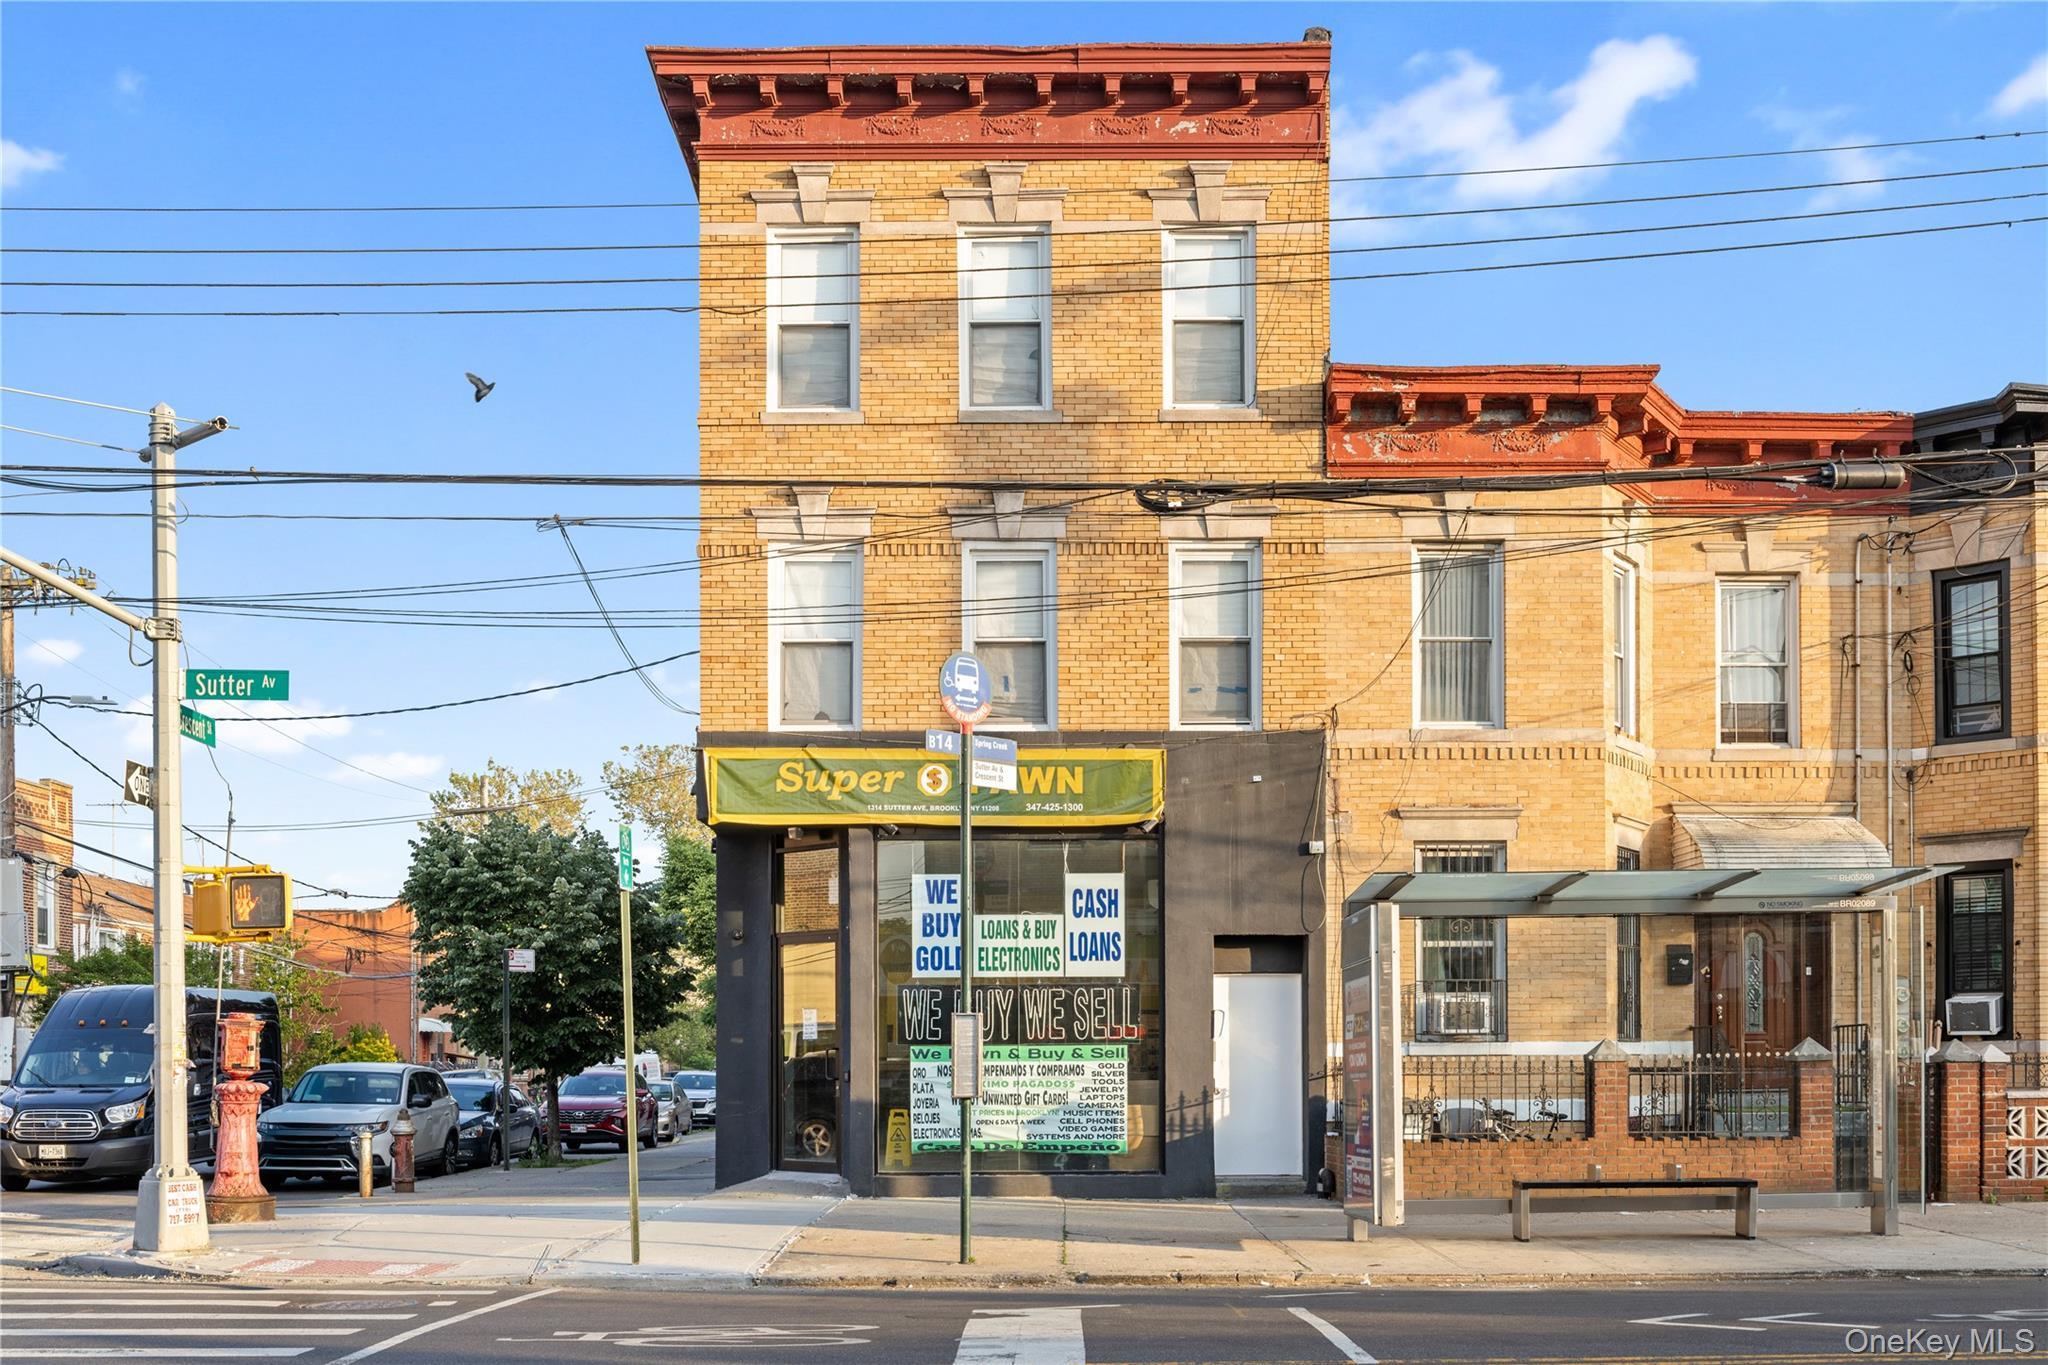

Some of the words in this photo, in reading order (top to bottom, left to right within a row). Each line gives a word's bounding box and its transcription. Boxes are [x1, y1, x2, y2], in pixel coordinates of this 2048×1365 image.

[195, 672, 254, 697] Sutter
[262, 674, 276, 688] Av
[180, 714, 206, 740] rescent
[928, 734, 953, 751] B14
[975, 739, 992, 750] Spring
[993, 741, 1008, 751] Creek
[134, 776, 149, 794] ONE
[774, 760, 904, 800] Super
[971, 766, 1084, 795] WN
[975, 772, 997, 782] Crescent
[1026, 803, 1084, 812] 347-425-1300
[925, 879, 958, 904] WE
[1072, 888, 1119, 918] CASH
[922, 913, 961, 938] BUY
[981, 919, 1019, 939] LOANS
[1022, 919, 1031, 939] &
[1034, 919, 1057, 939] BUY
[1069, 932, 1121, 961] LOANS
[978, 946, 1061, 972] ELECTRONICS
[903, 988, 942, 1040] WE
[954, 988, 1014, 1041] UY
[1023, 988, 1065, 1040] WE
[1073, 988, 1137, 1040] SELL
[912, 1049, 942, 1059] We
[1008, 1049, 1020, 1059] &
[1028, 1048, 1064, 1061] Buy
[1071, 1048, 1084, 1058] &
[1091, 1048, 1125, 1058] Sell
[912, 1067, 926, 1079] ORO
[983, 1065, 1027, 1077] MPENAMOS
[1029, 1065, 1035, 1076] Y
[1036, 1065, 1085, 1077] COMPRAMOS
[912, 1083, 934, 1094] PLATA
[912, 1098, 940, 1109] JOYERIA
[913, 1113, 940, 1124] RELOJES
[913, 1128, 961, 1139] ELECTRONICAS
[984, 1142, 1014, 1151] De
[1021, 1141, 1120, 1152] Empeño
